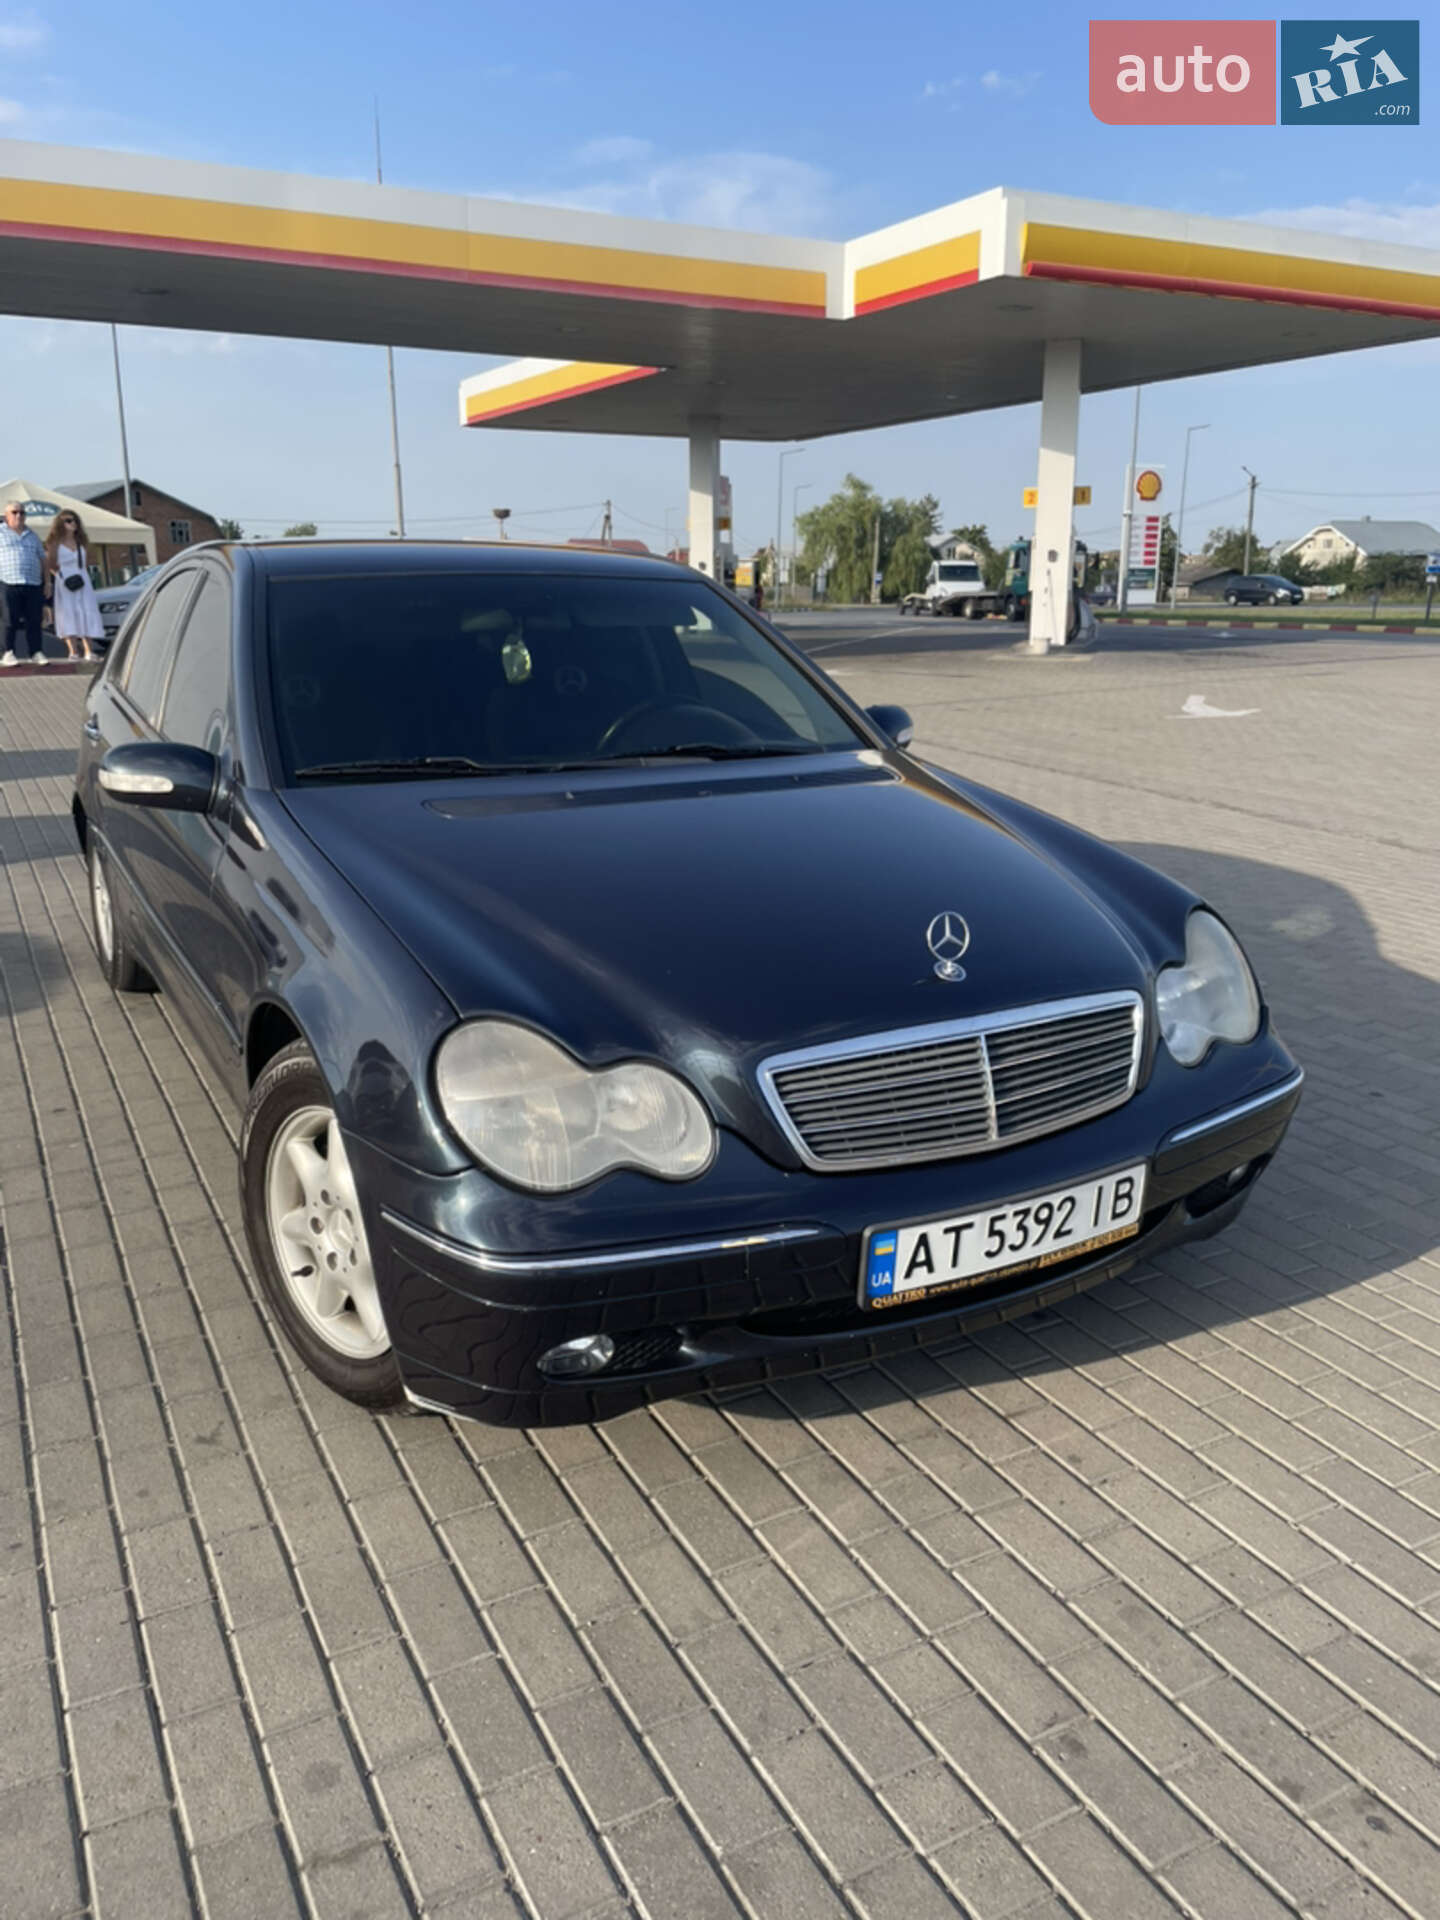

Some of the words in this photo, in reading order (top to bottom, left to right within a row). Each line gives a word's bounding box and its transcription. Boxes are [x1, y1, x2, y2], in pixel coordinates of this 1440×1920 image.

[903, 1221, 974, 1280] AT
[984, 1196, 1076, 1258] 5392
[1093, 1176, 1135, 1227] IB
[871, 1271, 892, 1288] UA
[872, 1287, 928, 1309] QUATTRO
